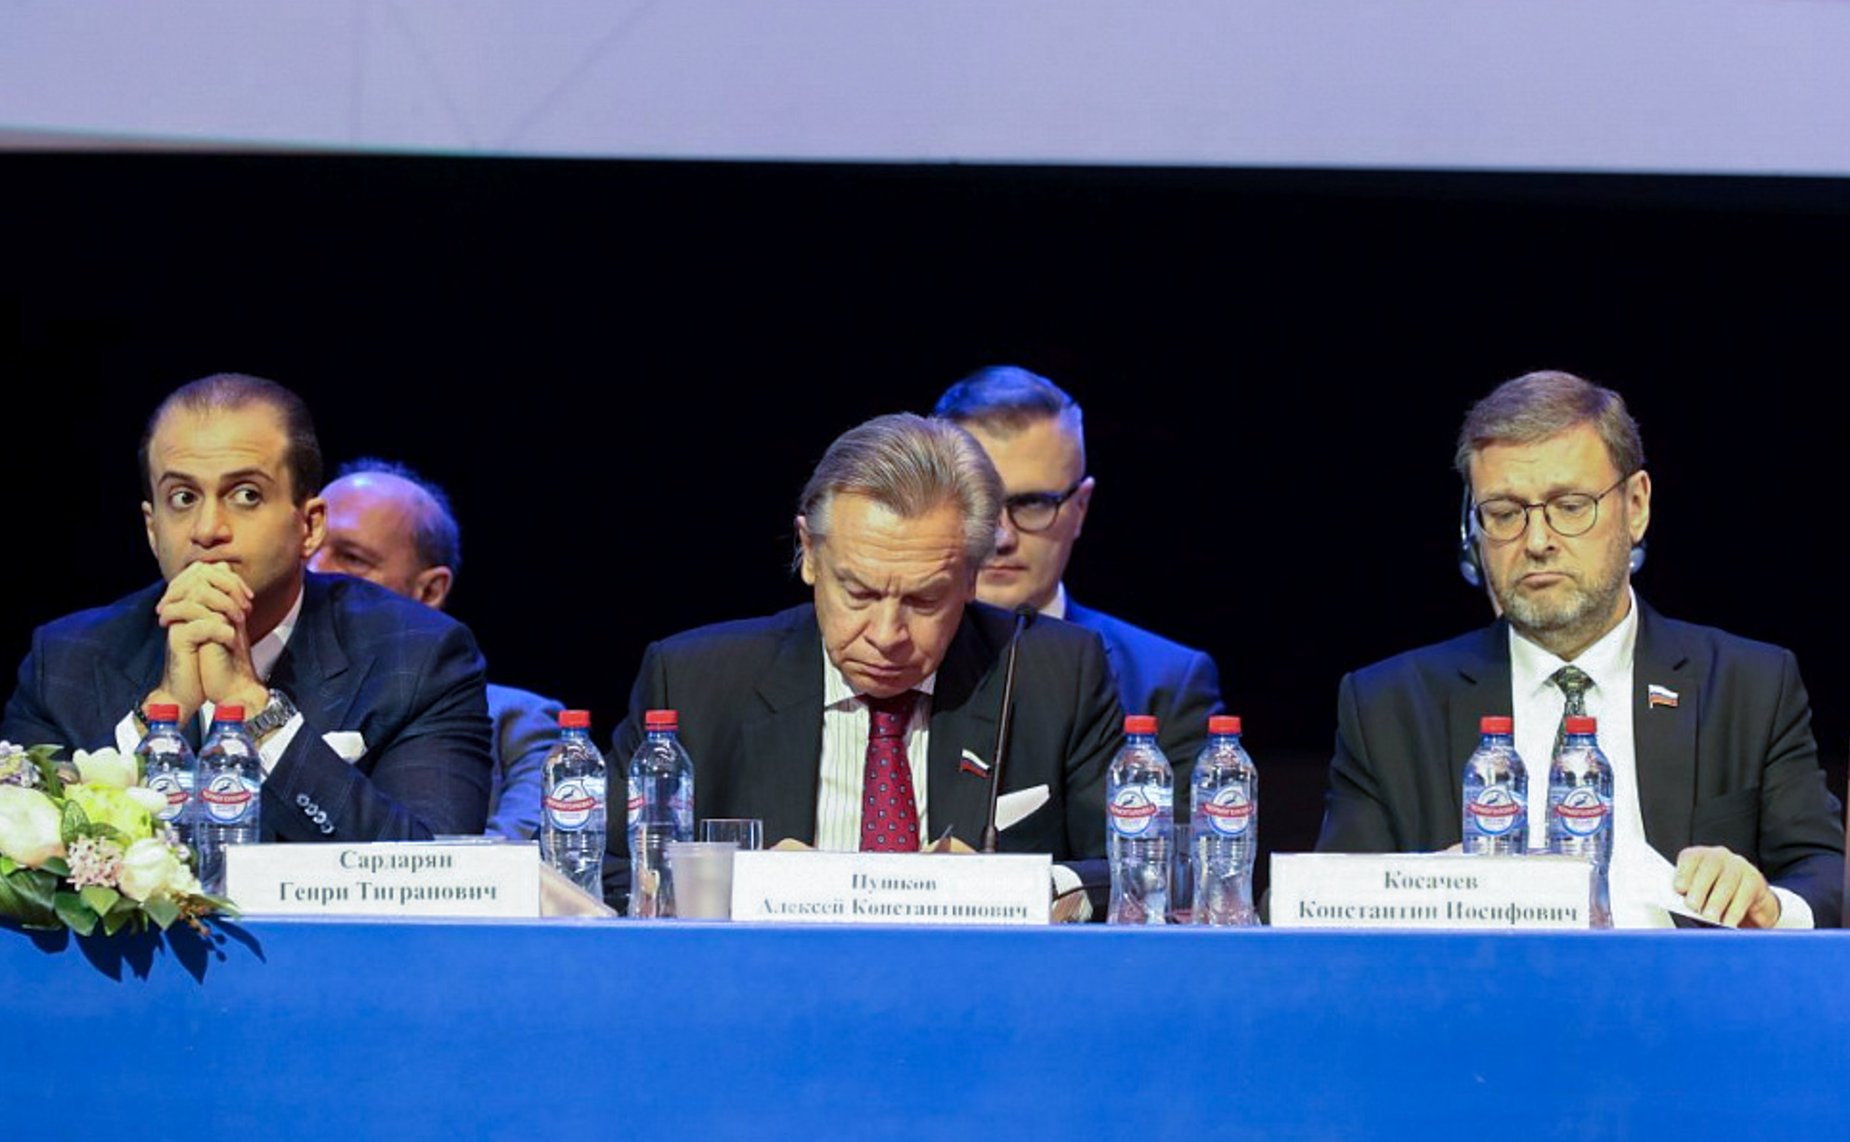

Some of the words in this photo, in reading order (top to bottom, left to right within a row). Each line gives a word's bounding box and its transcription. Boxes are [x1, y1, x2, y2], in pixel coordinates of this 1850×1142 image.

[339, 849, 453, 873] Сардарян
[851, 873, 937, 894] Пушков
[1384, 871, 1479, 890] Косачев
[279, 881, 349, 905] Генри
[357, 881, 497, 905] Тигранович
[759, 898, 845, 915] Алексей
[851, 898, 1028, 919] Константинович
[1299, 901, 1438, 920] Константин
[1446, 901, 1578, 925] Иосифович
